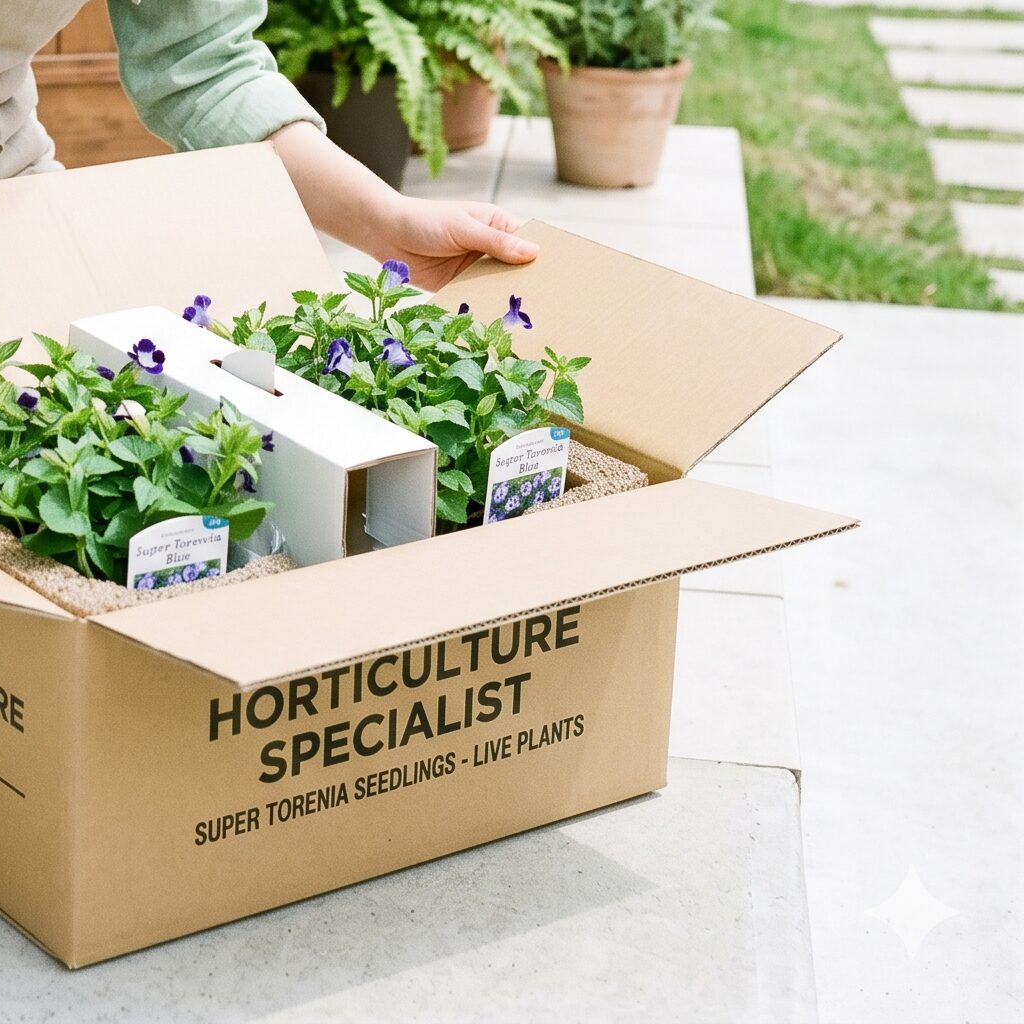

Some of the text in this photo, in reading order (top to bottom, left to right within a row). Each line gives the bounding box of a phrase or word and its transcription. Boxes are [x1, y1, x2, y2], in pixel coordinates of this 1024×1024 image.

[166, 552, 191, 565] Blue
[208, 605, 581, 742] HORTICULTURE
[258, 672, 532, 783] SPECIALIST
[194, 807, 260, 846] SUPER
[266, 782, 349, 826] TORENIA
[354, 752, 456, 801] SEEDLINGS
[473, 735, 513, 768] LIVE
[517, 714, 585, 755] PLANTS
